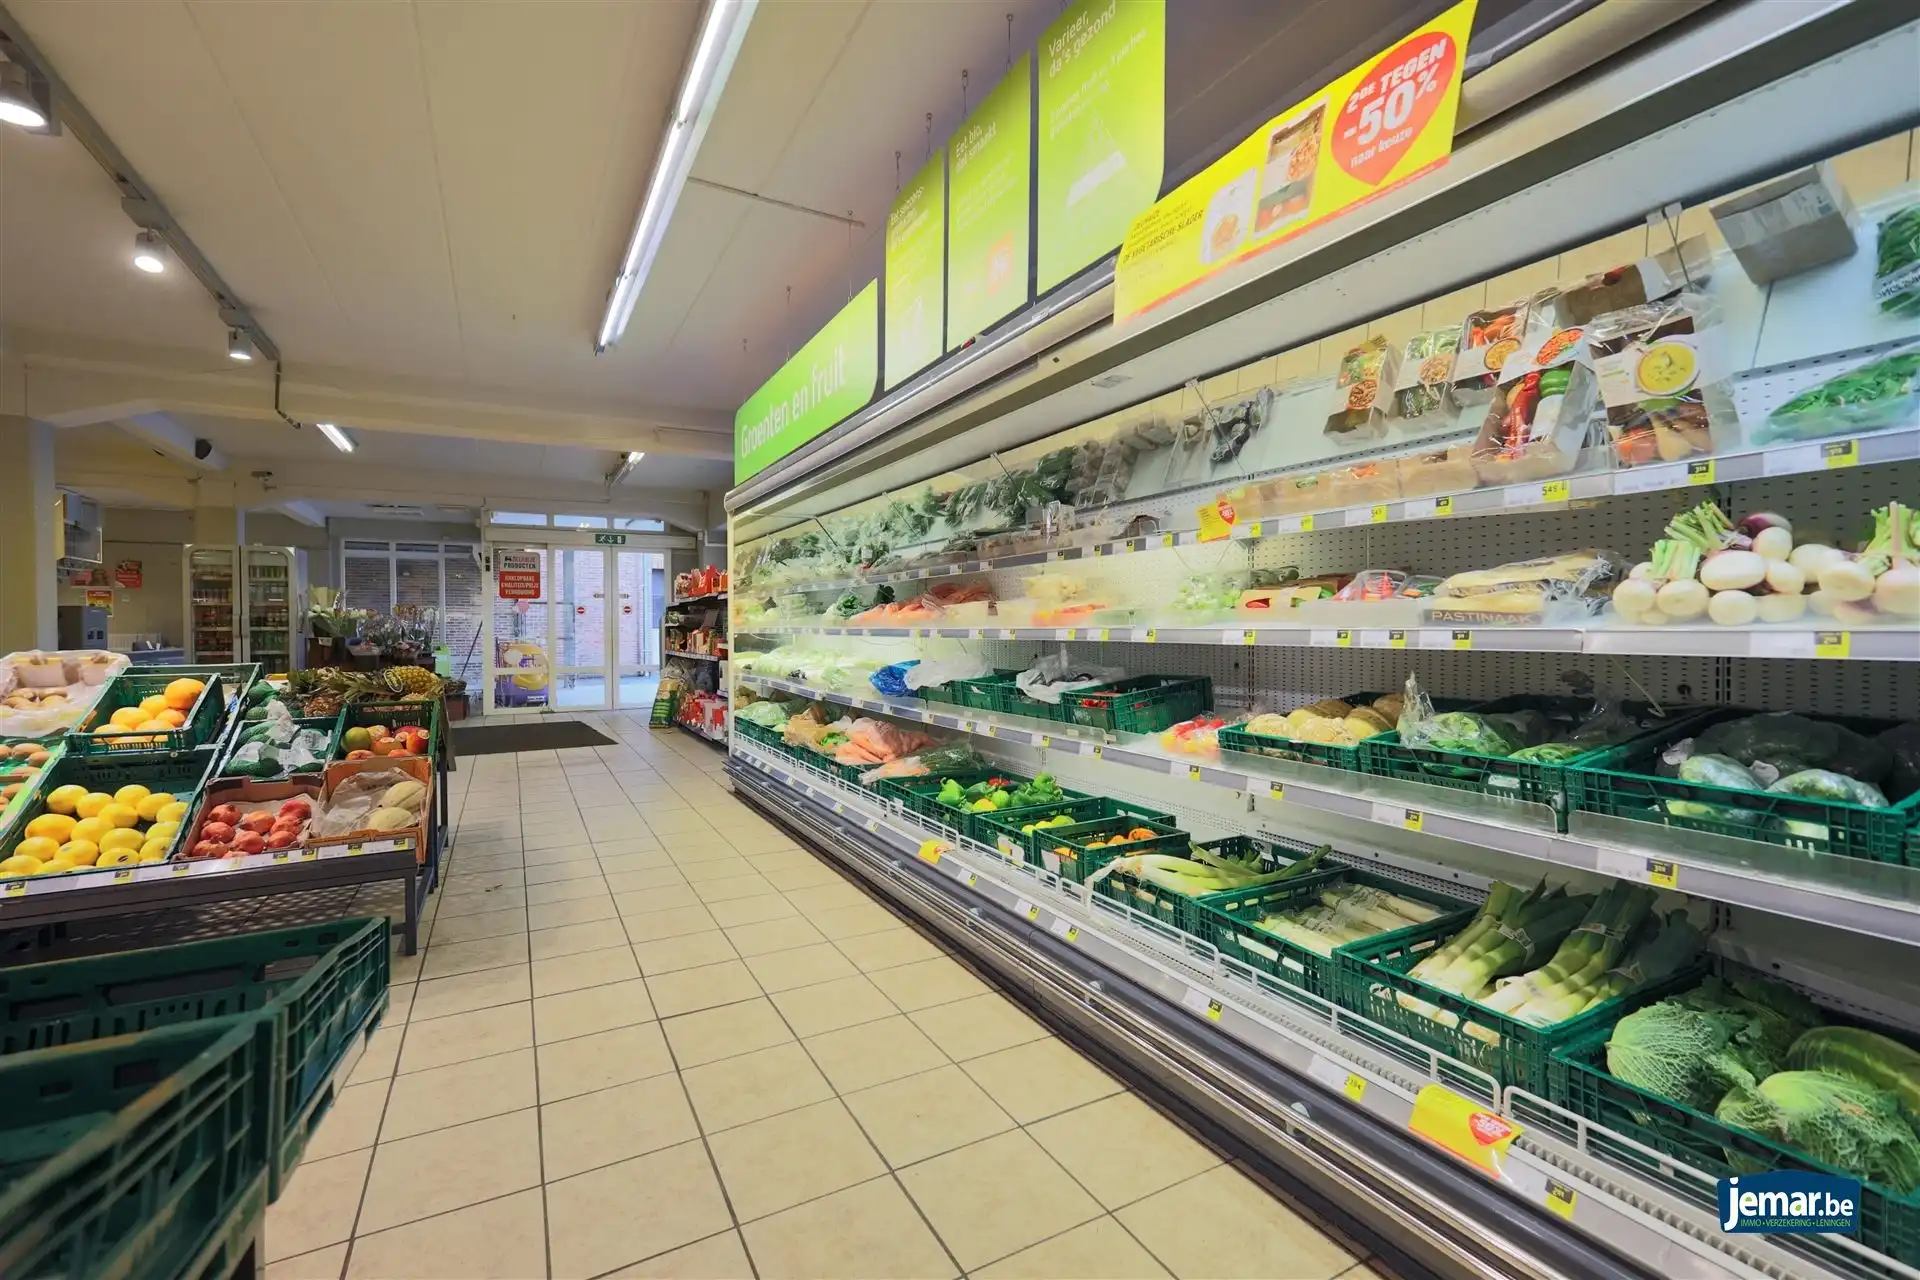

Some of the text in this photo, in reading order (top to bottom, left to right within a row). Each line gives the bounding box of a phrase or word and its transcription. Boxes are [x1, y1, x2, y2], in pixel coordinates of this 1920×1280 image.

[1048, 10, 1089, 58] Varieer,
[1073, 1, 1116, 60] gezond
[1379, 36, 1448, 93] TEGEN
[1343, 62, 1440, 146] -50%
[1350, 146, 1377, 169] naar
[741, 342, 845, 460] Groenten en fruit
[1432, 610, 1532, 624] PASTINAAK
